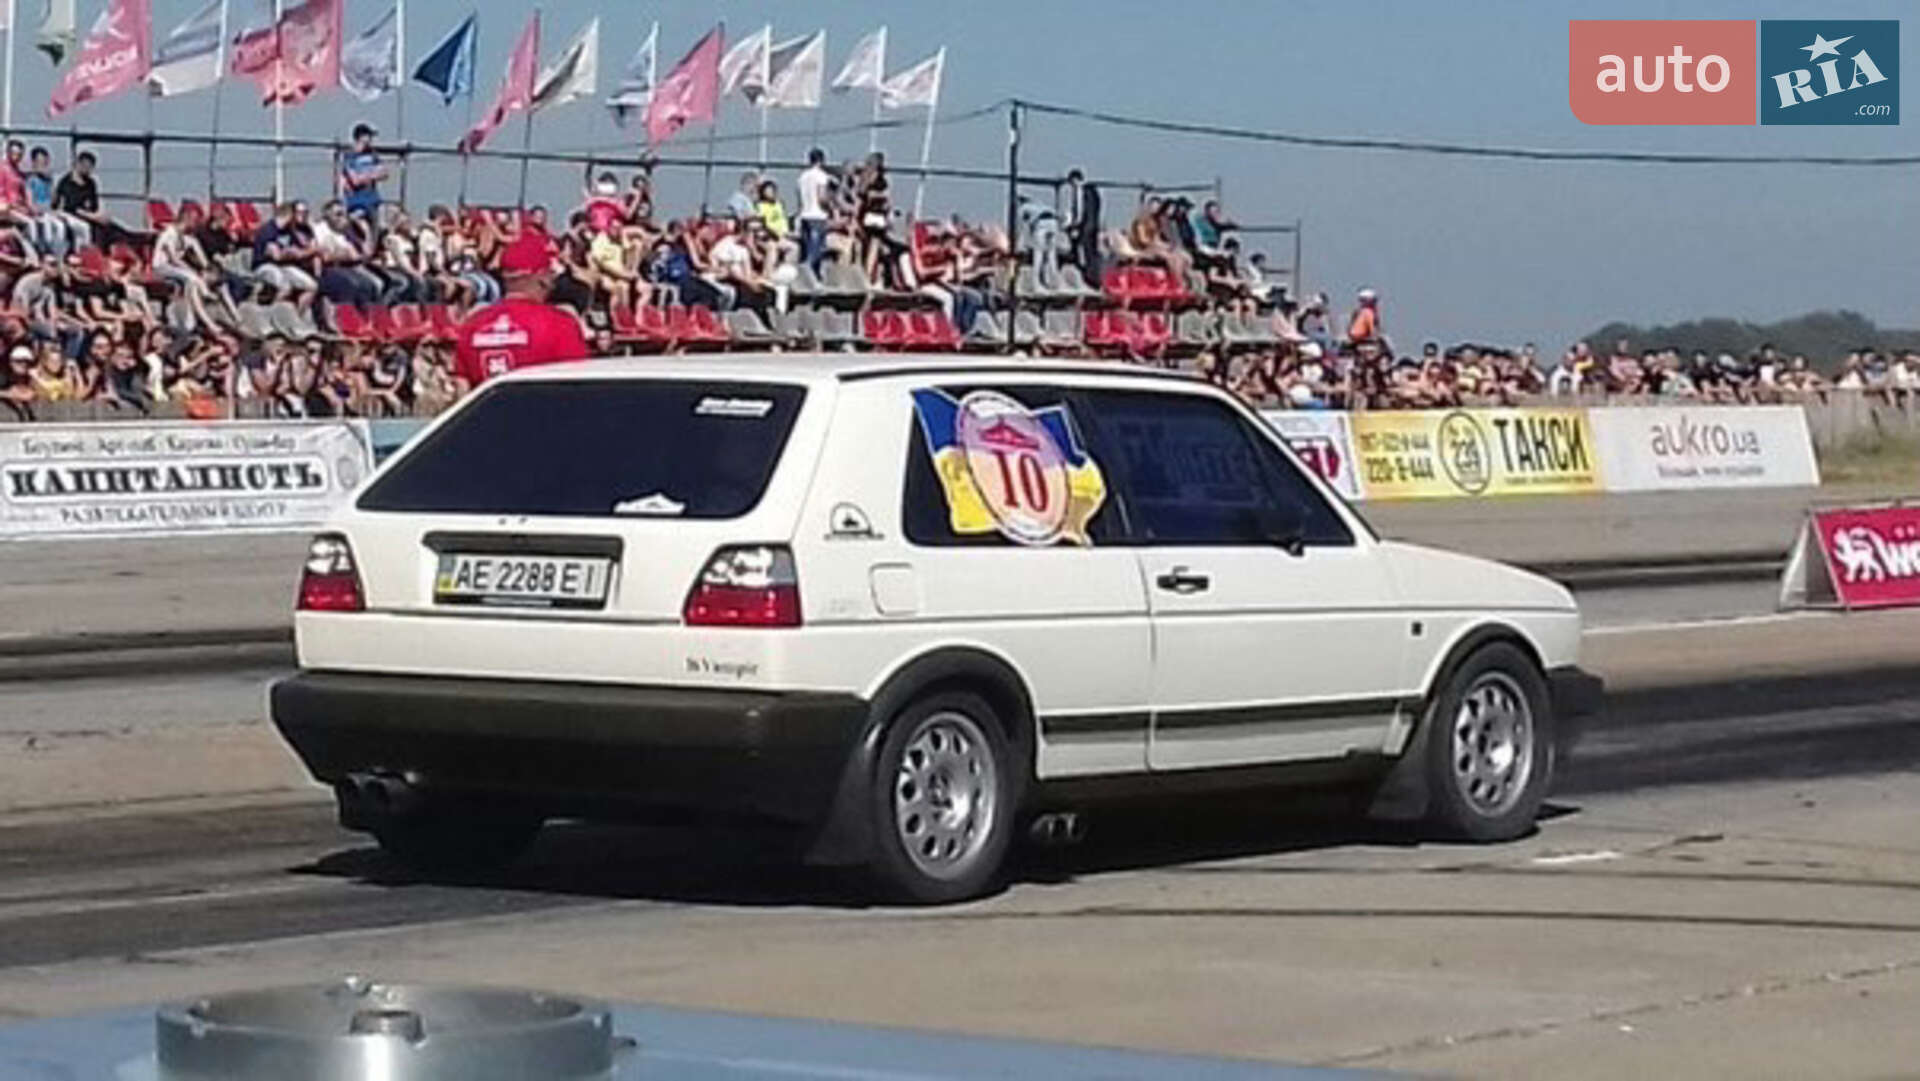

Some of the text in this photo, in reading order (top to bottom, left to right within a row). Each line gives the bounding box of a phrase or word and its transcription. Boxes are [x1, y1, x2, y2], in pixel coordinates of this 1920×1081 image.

[1493, 417, 1590, 472] ТАКСИ
[1651, 415, 1761, 455] aukro.ua
[992, 449, 1049, 512] 10
[455, 560, 492, 590] AE
[496, 560, 557, 592] 2288
